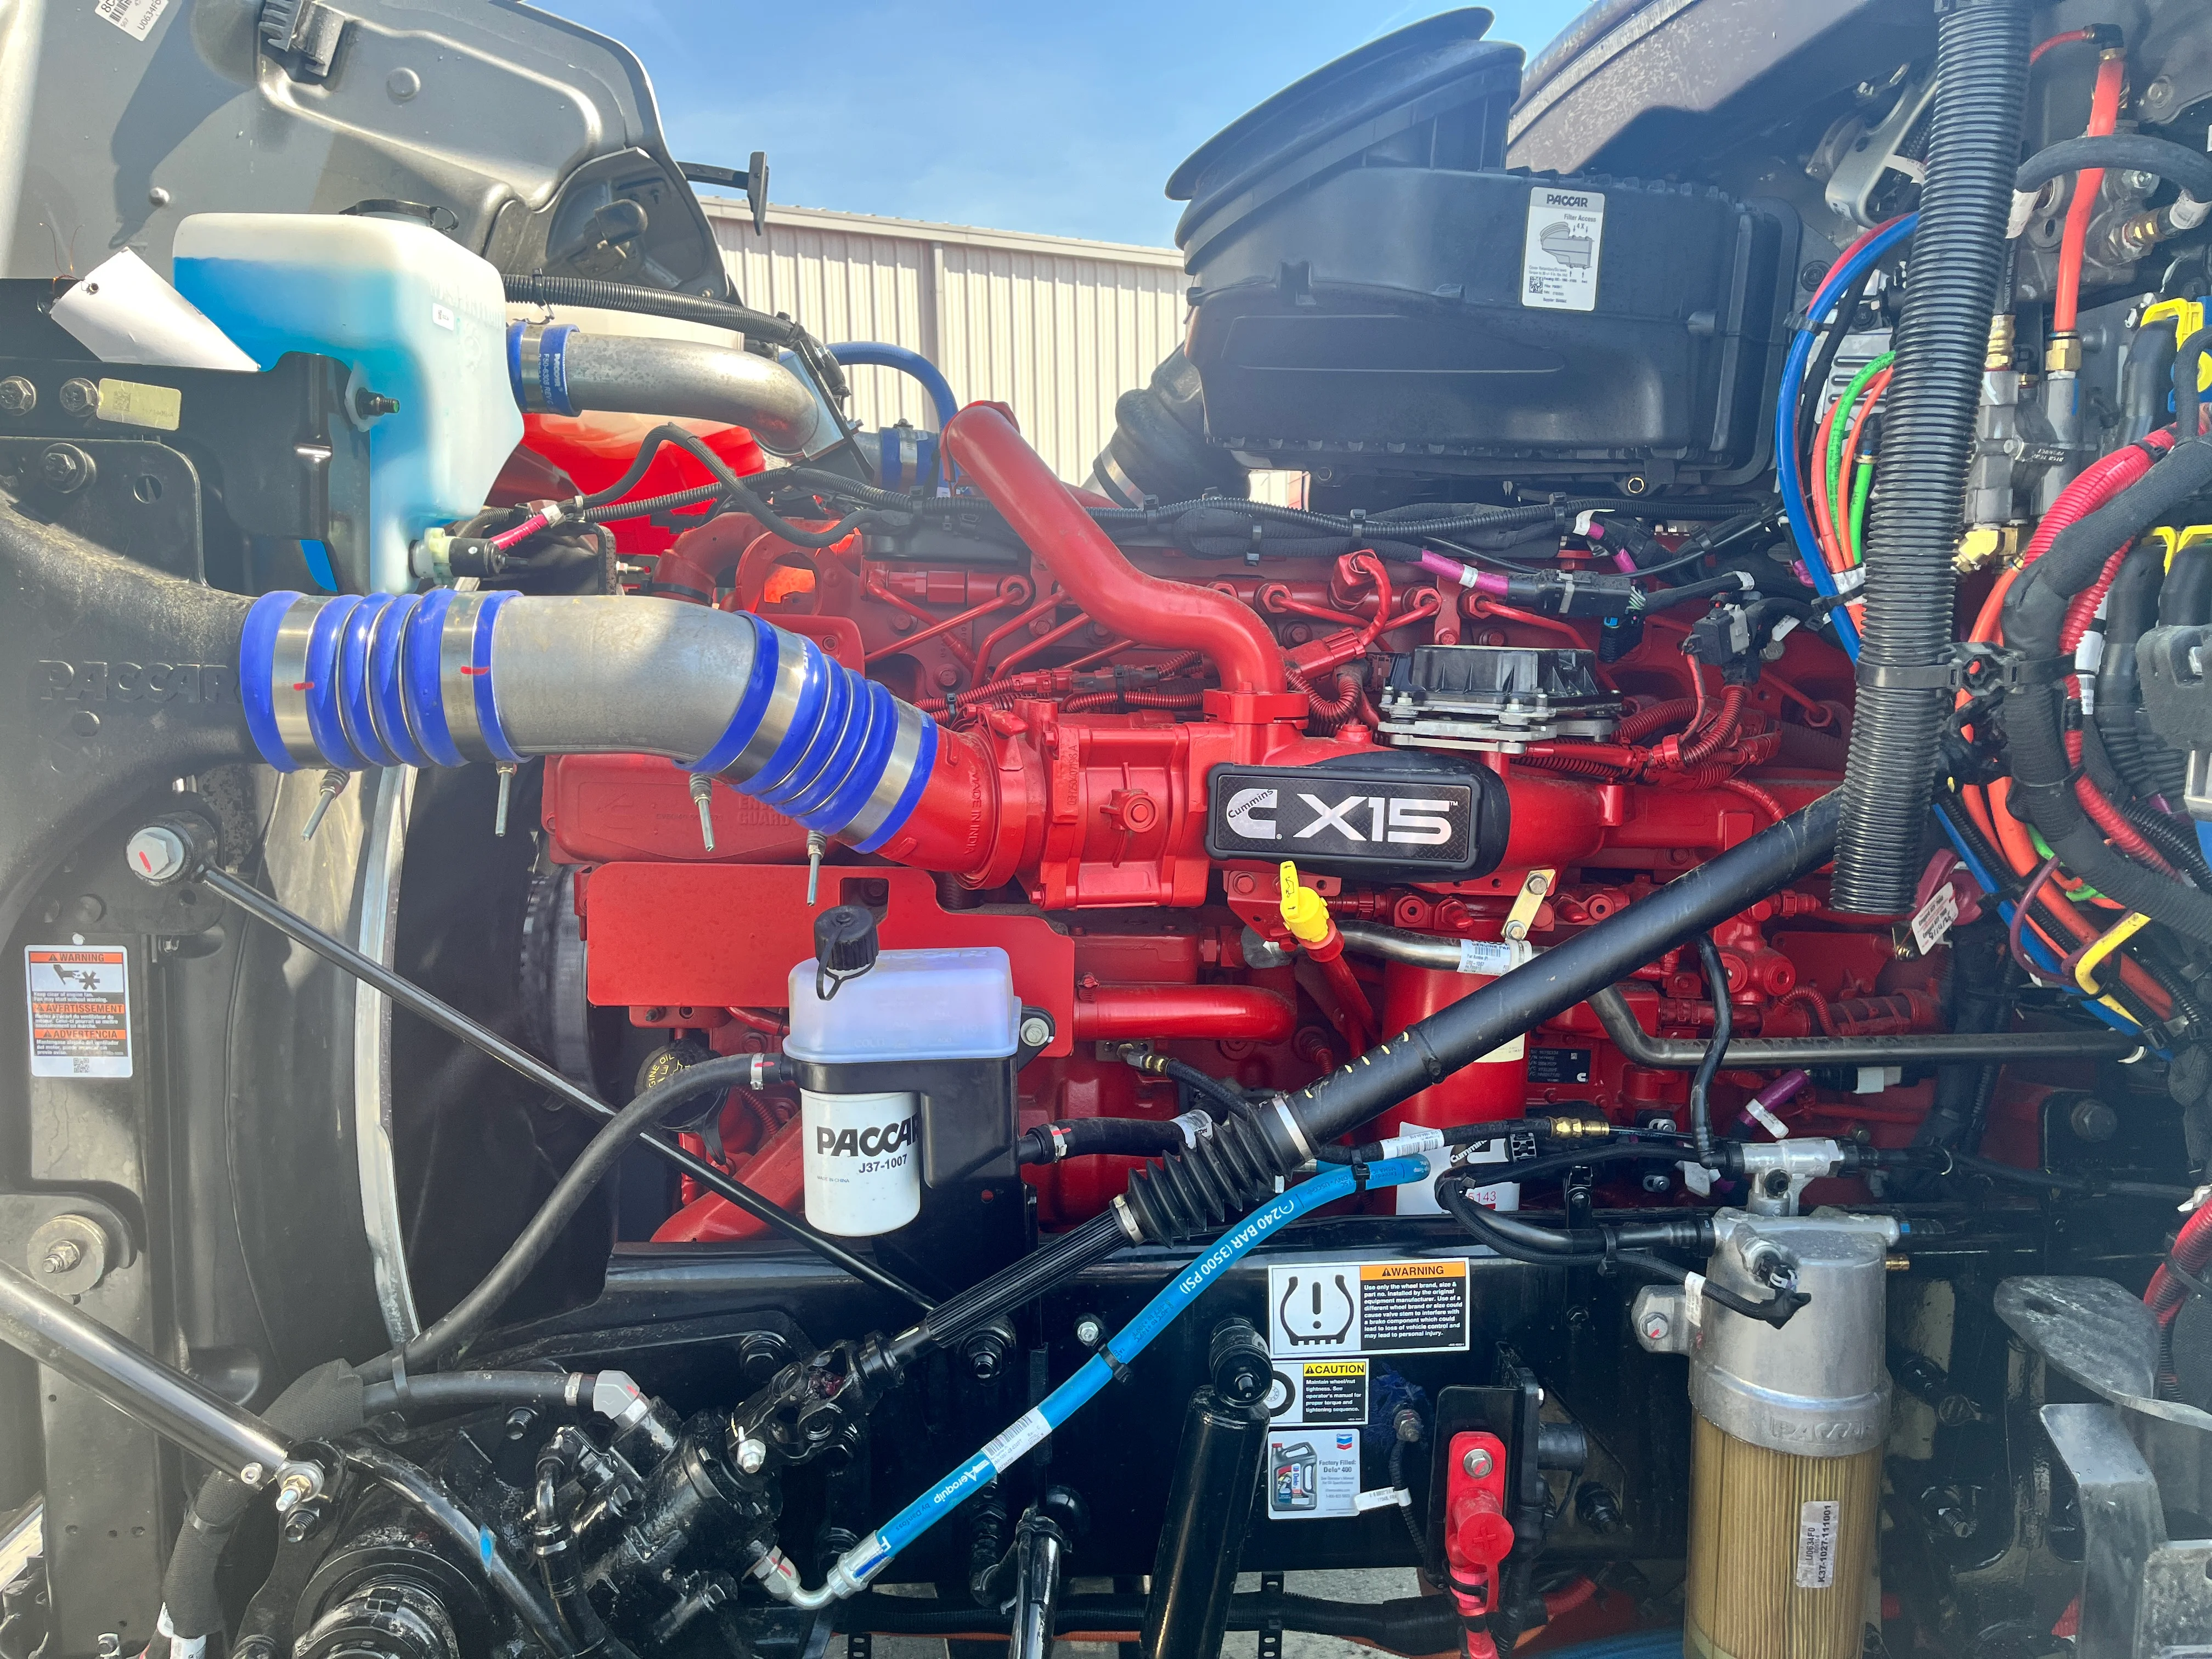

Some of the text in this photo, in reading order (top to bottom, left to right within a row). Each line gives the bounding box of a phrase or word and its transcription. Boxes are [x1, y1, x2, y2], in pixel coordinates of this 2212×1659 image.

[1547, 194, 1588, 207] PACCAR
[1228, 788, 1274, 819] Cummins
[971, 811, 981, 822] IN
[1293, 793, 1452, 845] X15
[964, 824, 980, 855] INDIA
[60, 953, 104, 962] WARNING
[47, 1005, 122, 1013] AVERTISSEMENT
[54, 1030, 117, 1039] ADVERTENCIA
[659, 1054, 675, 1064] OIL
[859, 1154, 907, 1173] J37-1007
[1179, 1206, 1282, 1295] 240 BAR (3500 PSI)
[1391, 1266, 1444, 1276] WARNING
[1315, 1364, 1364, 1373] CAUTION
[895, 1466, 979, 1531] Aeroquip by Danfoss
[1818, 1505, 1831, 1582] K37-1027-111001
